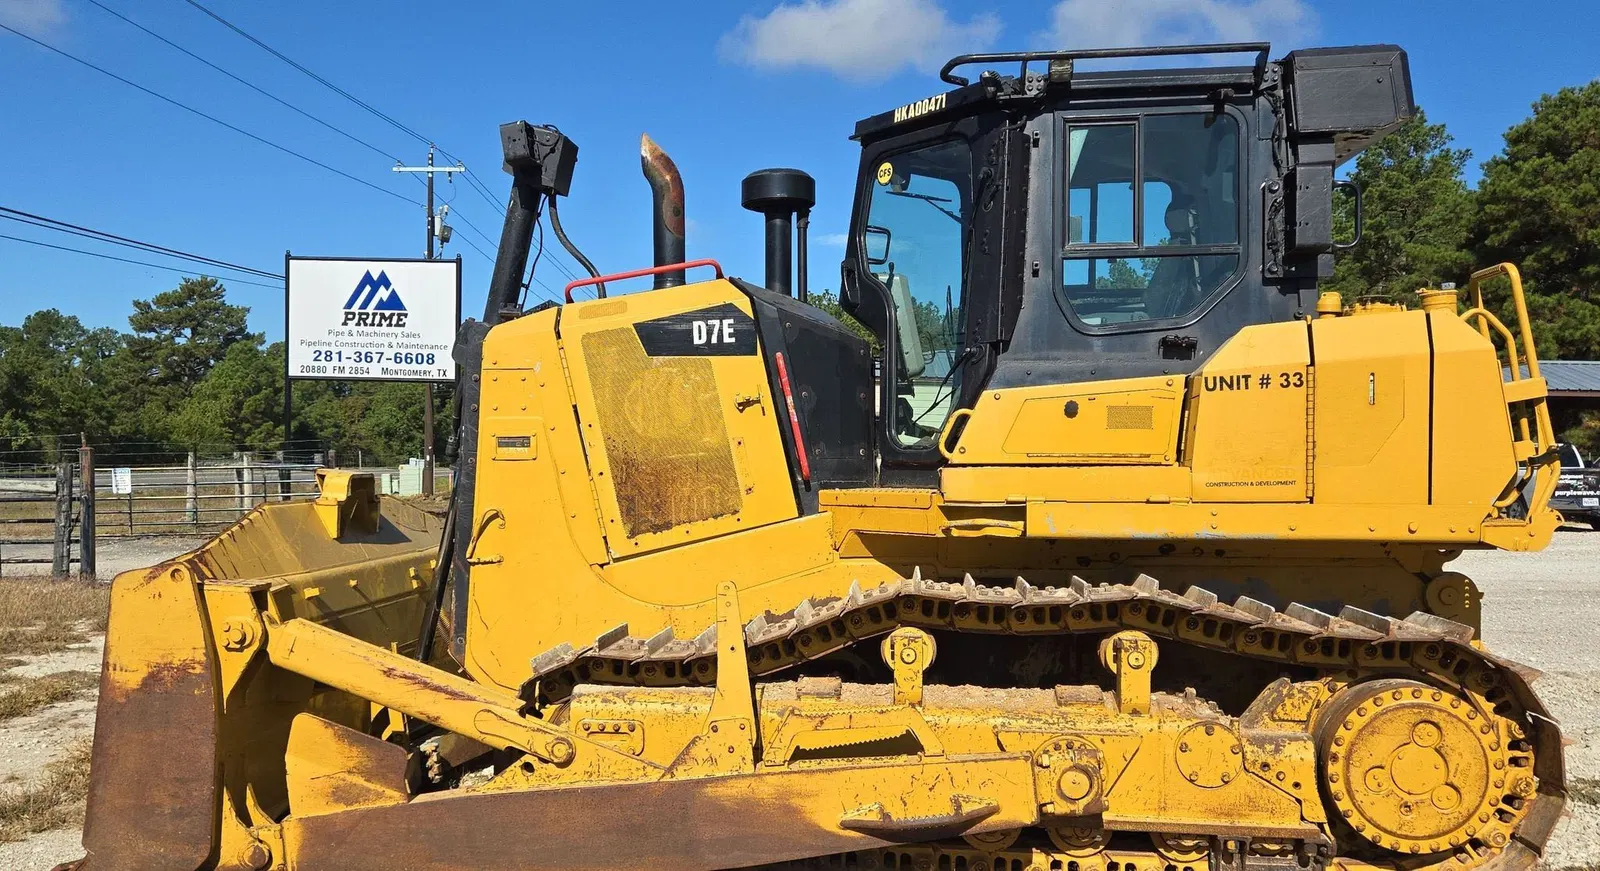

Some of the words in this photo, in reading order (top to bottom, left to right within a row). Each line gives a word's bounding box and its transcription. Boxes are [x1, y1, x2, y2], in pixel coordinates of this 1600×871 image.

[894, 93, 946, 123] HKA00471
[879, 167, 891, 179] CFS
[341, 311, 408, 327] PRIME
[328, 329, 345, 337] Pipe
[356, 330, 399, 339] Machinery
[692, 318, 736, 345] D7E
[334, 340, 385, 348] Construction
[396, 342, 448, 350] Maintenance
[312, 350, 435, 365] 281-367-6608
[300, 365, 327, 374] 20880
[332, 366, 345, 374] FM
[348, 366, 370, 375] 2854
[437, 369, 448, 377] TX
[1204, 374, 1251, 392] UNIT
[1258, 373, 1271, 389] #
[1279, 372, 1304, 388] 33
